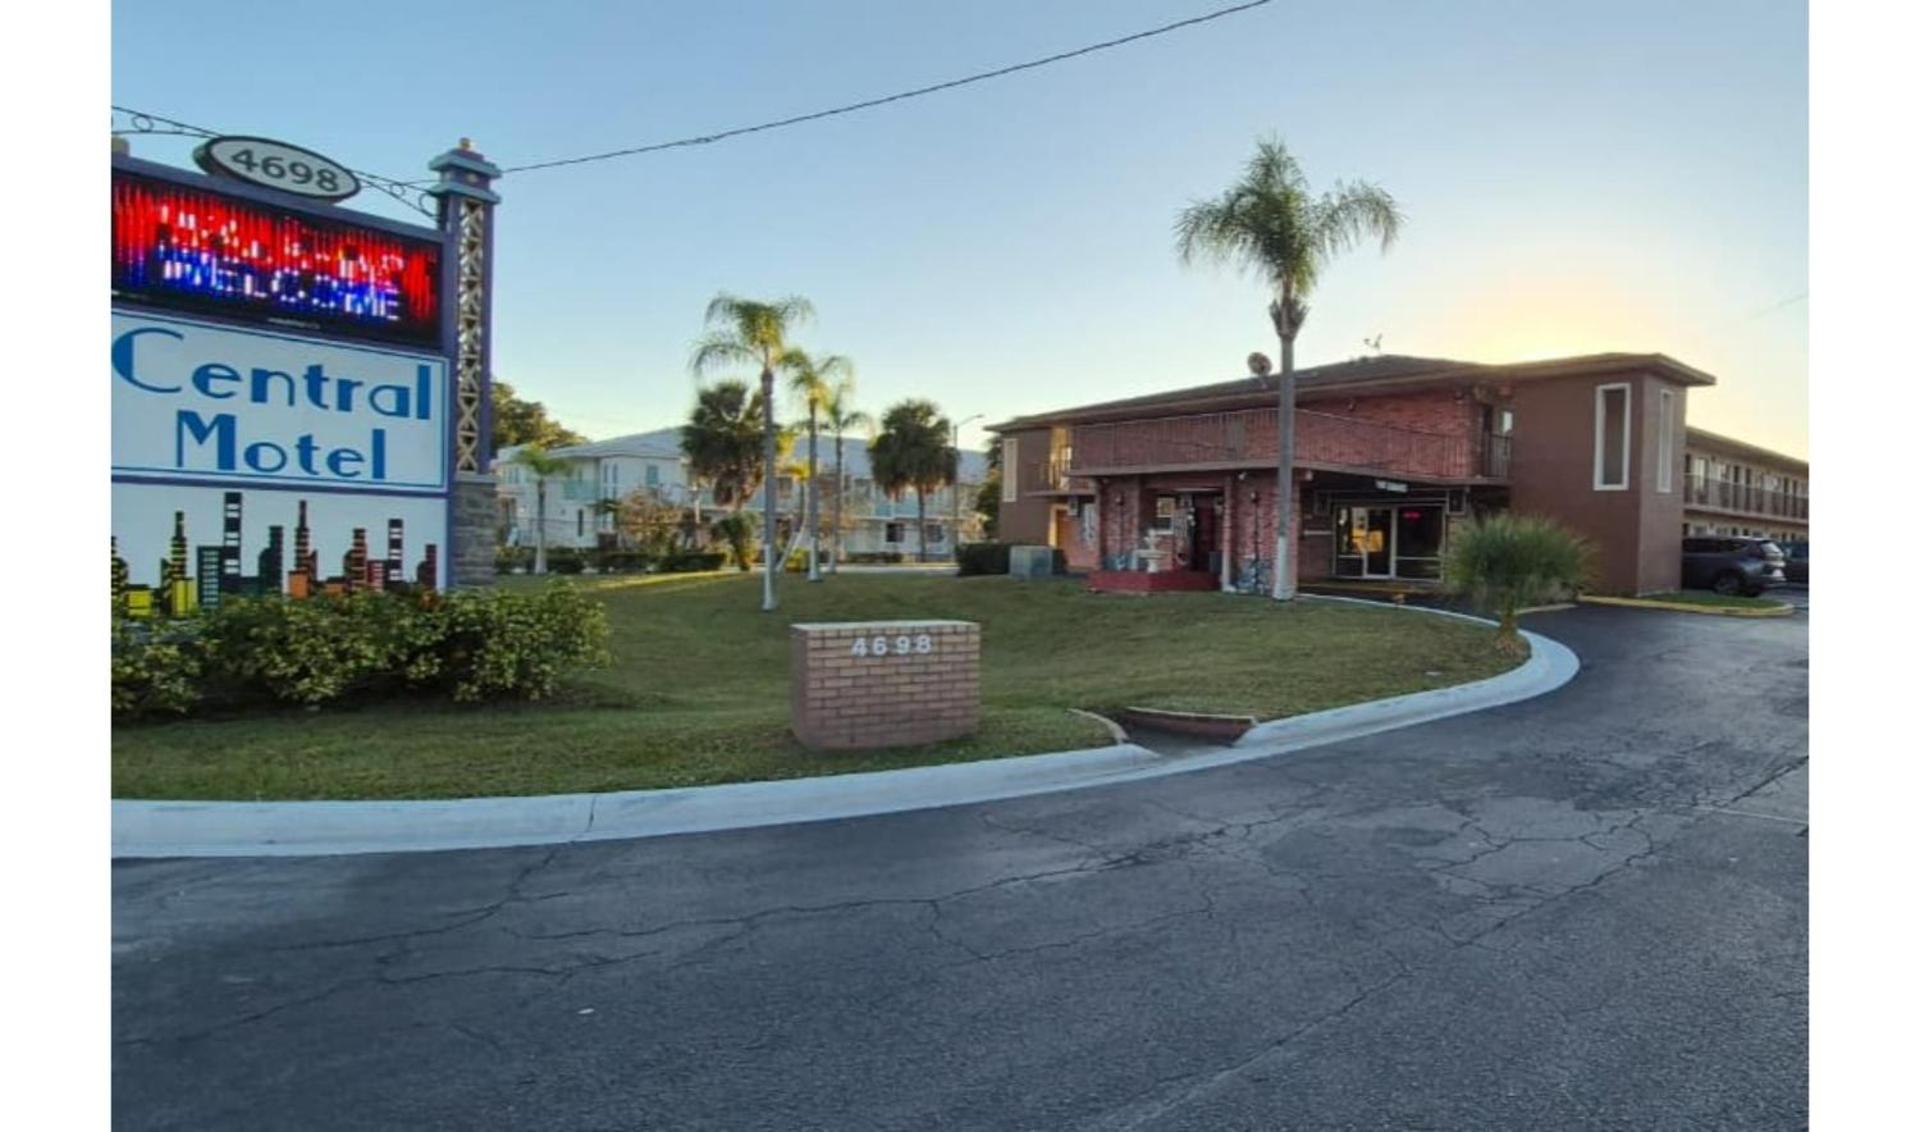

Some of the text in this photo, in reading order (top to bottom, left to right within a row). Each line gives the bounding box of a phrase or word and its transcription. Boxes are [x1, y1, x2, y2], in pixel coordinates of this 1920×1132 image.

[231, 147, 339, 193] 4698
[160, 242, 398, 320] WELCOME
[112, 327, 431, 420] Central
[176, 409, 386, 480] Motel
[852, 634, 932, 657] 4698
